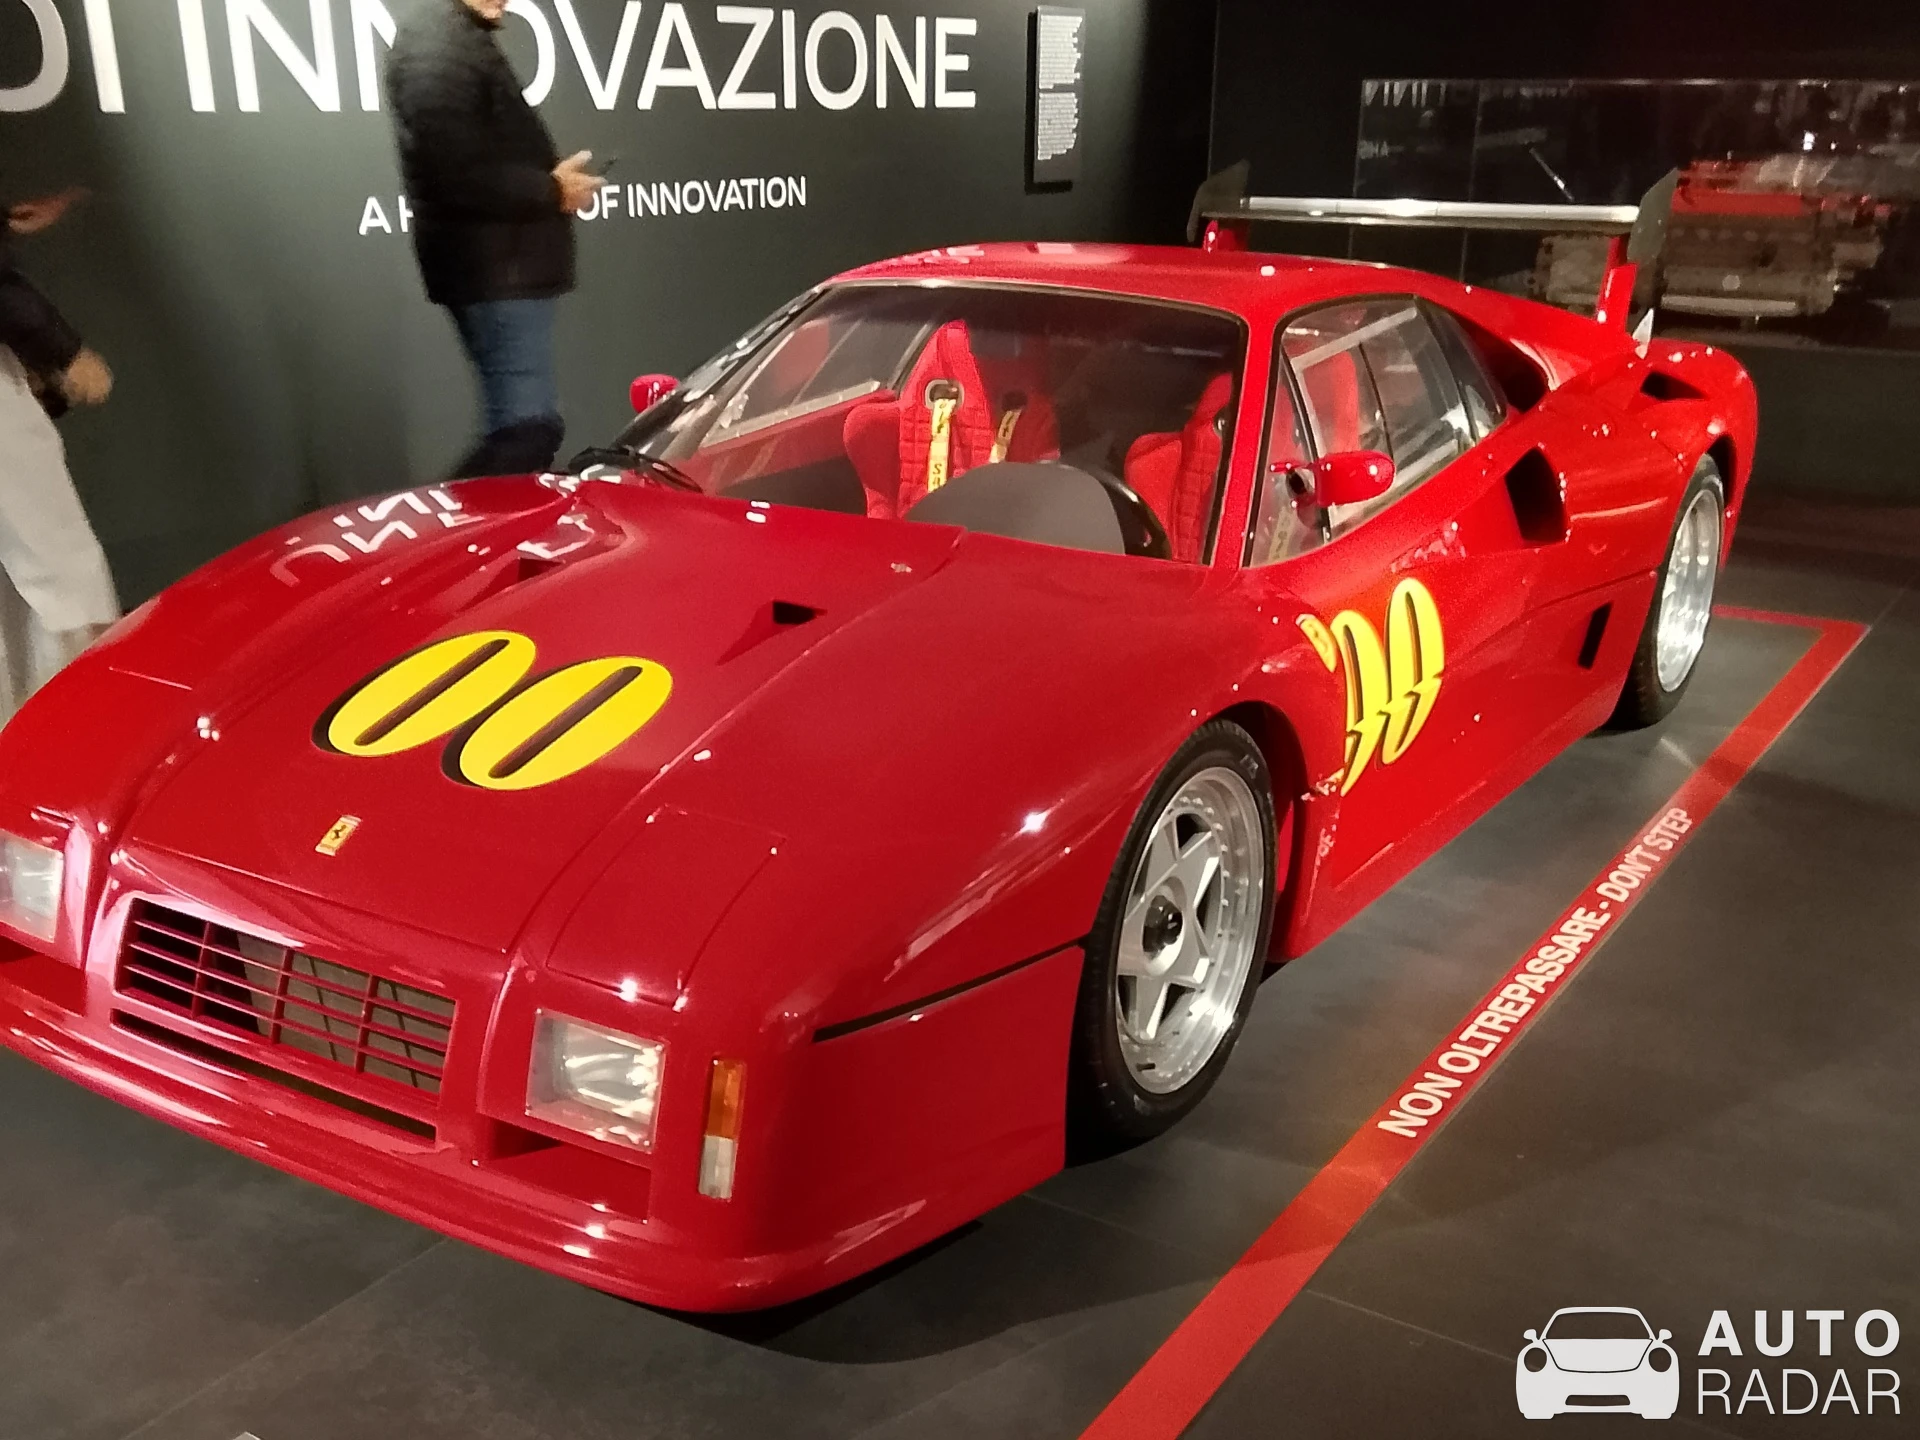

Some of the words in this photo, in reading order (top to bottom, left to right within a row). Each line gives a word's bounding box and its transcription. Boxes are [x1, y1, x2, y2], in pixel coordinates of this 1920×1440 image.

[358, 196, 392, 235] A
[627, 175, 807, 218] INNOVATION
[312, 630, 673, 790] 00
[1377, 1072, 1462, 1138] NON
[1438, 907, 1611, 1075] OLTREPASSARE
[1596, 845, 1661, 903] DON'T
[1643, 807, 1693, 851] STEP
